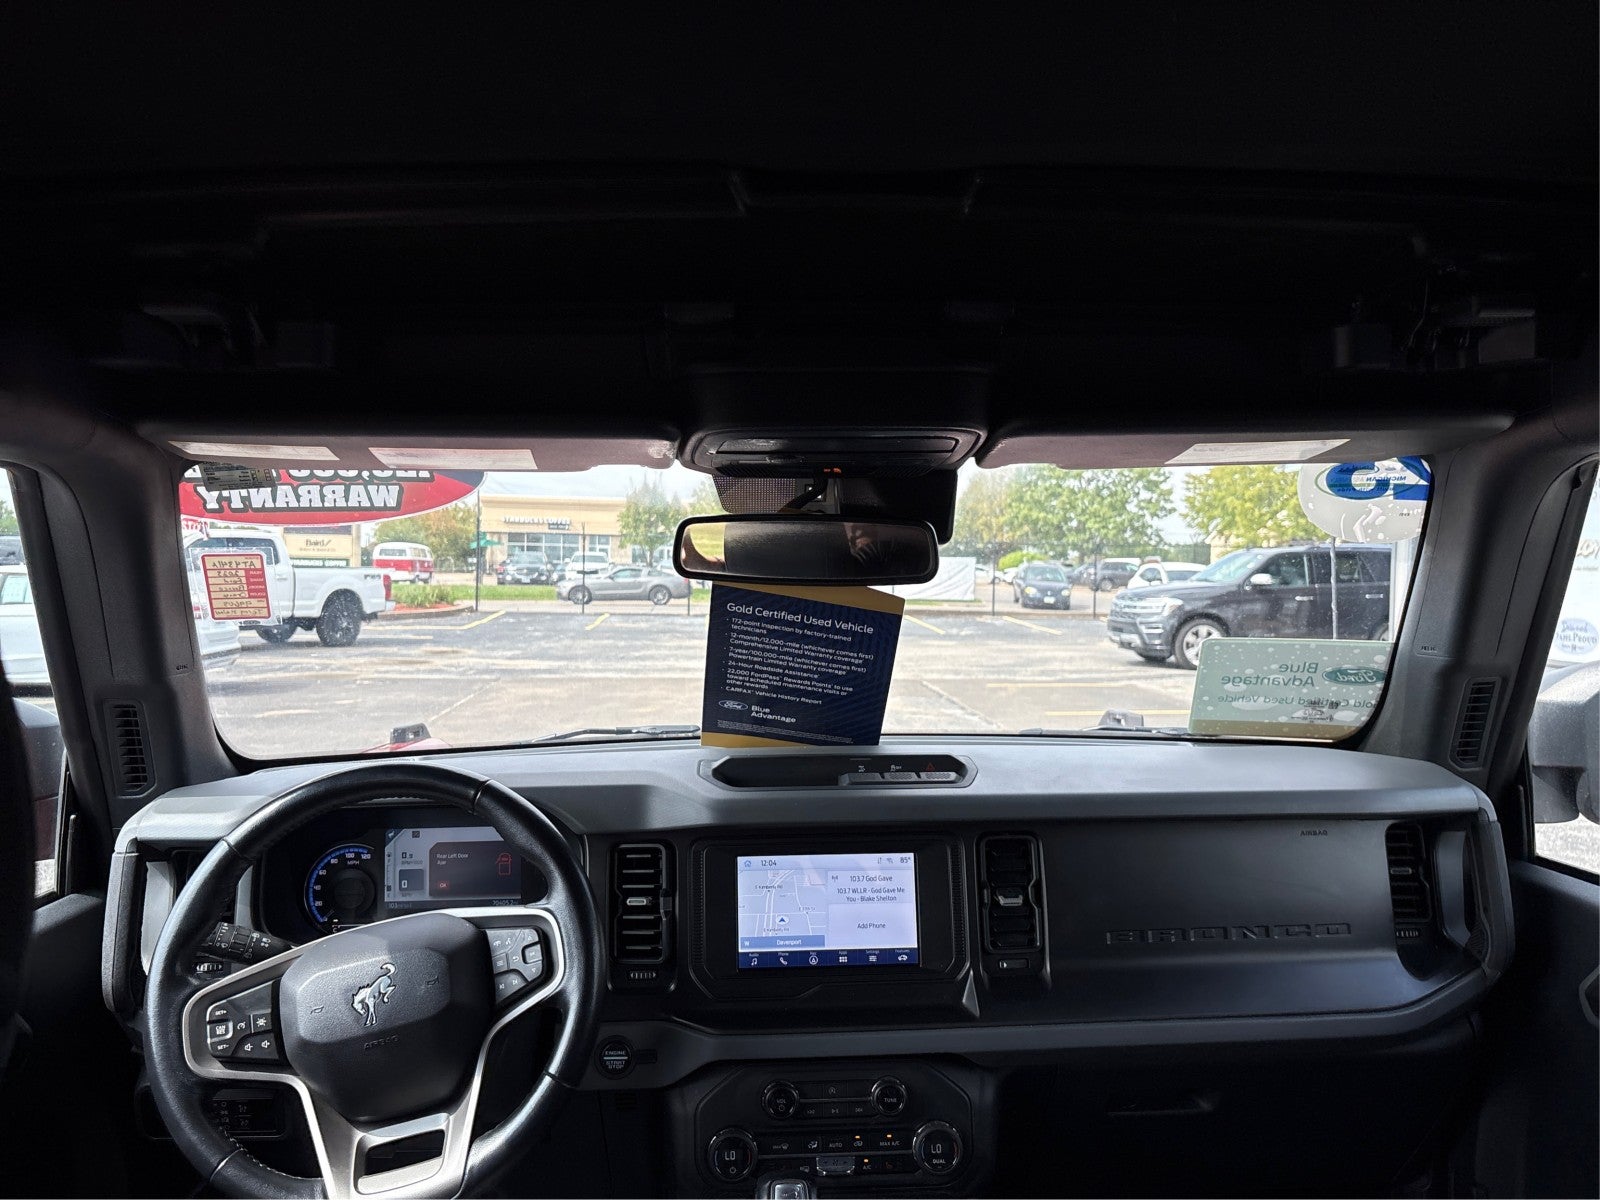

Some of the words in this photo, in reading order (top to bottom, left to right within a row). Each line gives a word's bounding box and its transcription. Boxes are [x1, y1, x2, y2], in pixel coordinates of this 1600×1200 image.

[726, 602, 753, 614] Gold
[755, 607, 802, 622] Certified
[803, 615, 832, 627] Used
[834, 620, 874, 634] Vehicle
[731, 624, 767, 634] technicians
[729, 638, 779, 650] Comprehensive
[779, 646, 803, 655] Limited
[804, 650, 833, 660] Warranty
[728, 652, 763, 662] Powertrain
[763, 658, 787, 666] Limited
[788, 662, 817, 671] Warranty
[754, 664, 784, 673] Roadside
[749, 677, 781, 685] scheduled
[782, 682, 823, 692] maintenance
[783, 676, 811, 685] Rewards
[755, 690, 777, 698] Vehicle
[778, 694, 800, 702] History
[801, 697, 822, 705] Report
[751, 705, 771, 713] Blue
[750, 711, 797, 723] Advantage
[761, 859, 777, 867] 12:04
[1106, 922, 1352, 944] BRONCO
